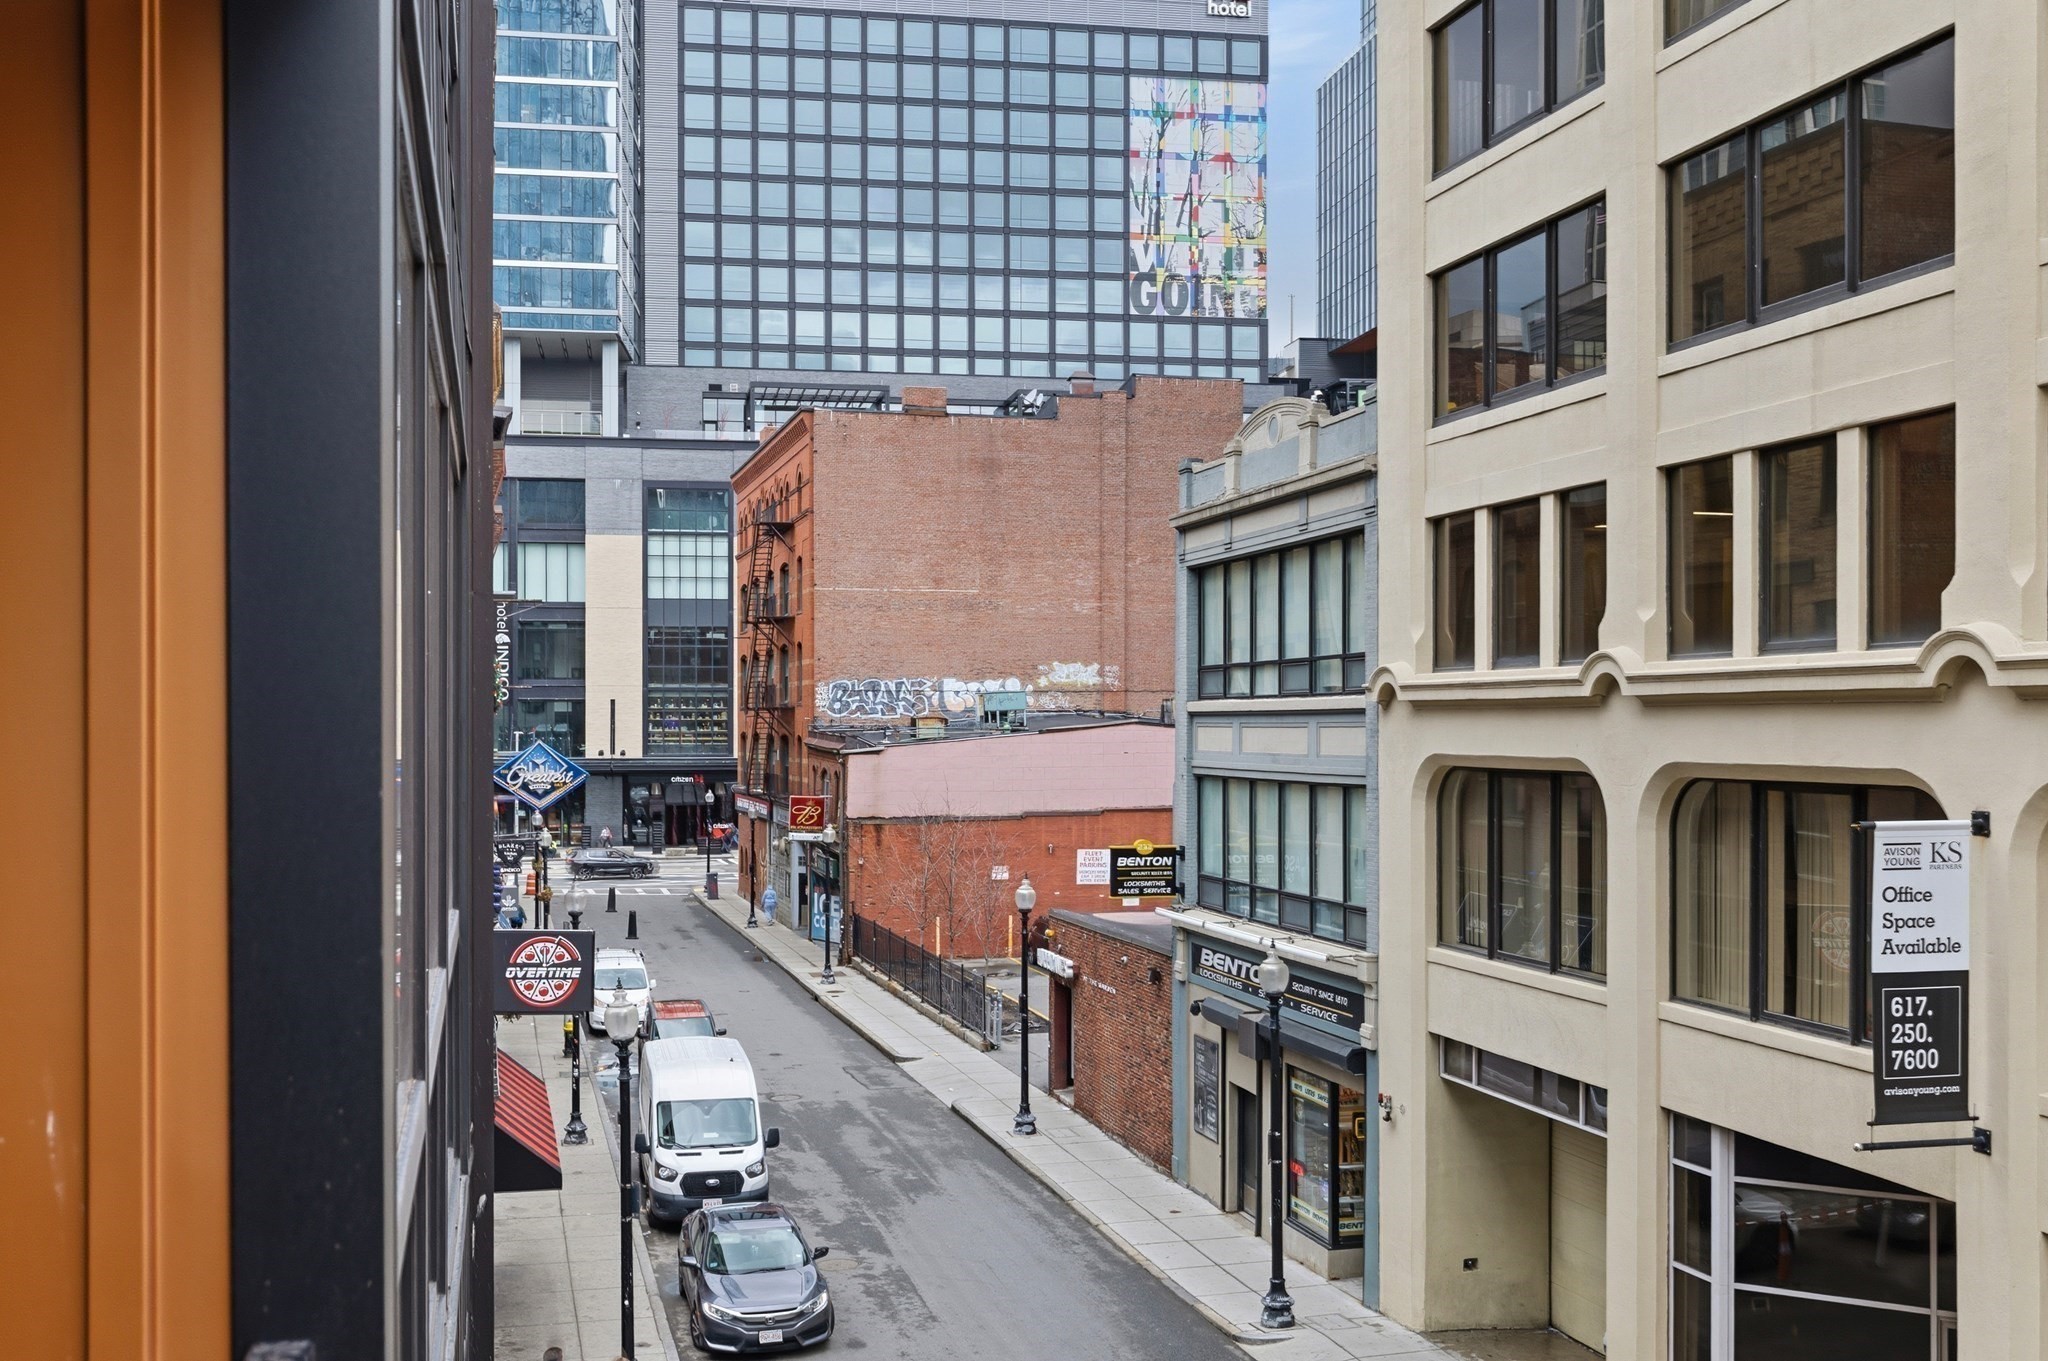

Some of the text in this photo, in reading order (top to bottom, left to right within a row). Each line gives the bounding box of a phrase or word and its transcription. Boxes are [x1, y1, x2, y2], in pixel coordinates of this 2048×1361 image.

[1208, 0, 1252, 17] hotel
[506, 765, 574, 790] Greatest
[1117, 857, 1173, 866] BENTON
[1884, 847, 1920, 856] AVISON
[1884, 857, 1920, 866] YOUNG
[1929, 841, 1962, 864] KS
[1882, 886, 1933, 903] Office
[1882, 912, 1935, 933] Space
[1881, 937, 1962, 955] Available
[505, 967, 582, 979] OVERTIME
[1200, 948, 1260, 983] BENTO
[1200, 968, 1242, 990] LOCKSMITHS
[1292, 981, 1317, 997] SECURITY
[1318, 990, 1334, 1002] SINCE
[1300, 1003, 1338, 1023] SERVICE
[1890, 996, 1934, 1017] 617.
[1890, 1022, 1933, 1044] 250.
[1891, 1048, 1939, 1071] 7600
[1883, 1085, 1961, 1097] avisonyoung.com
